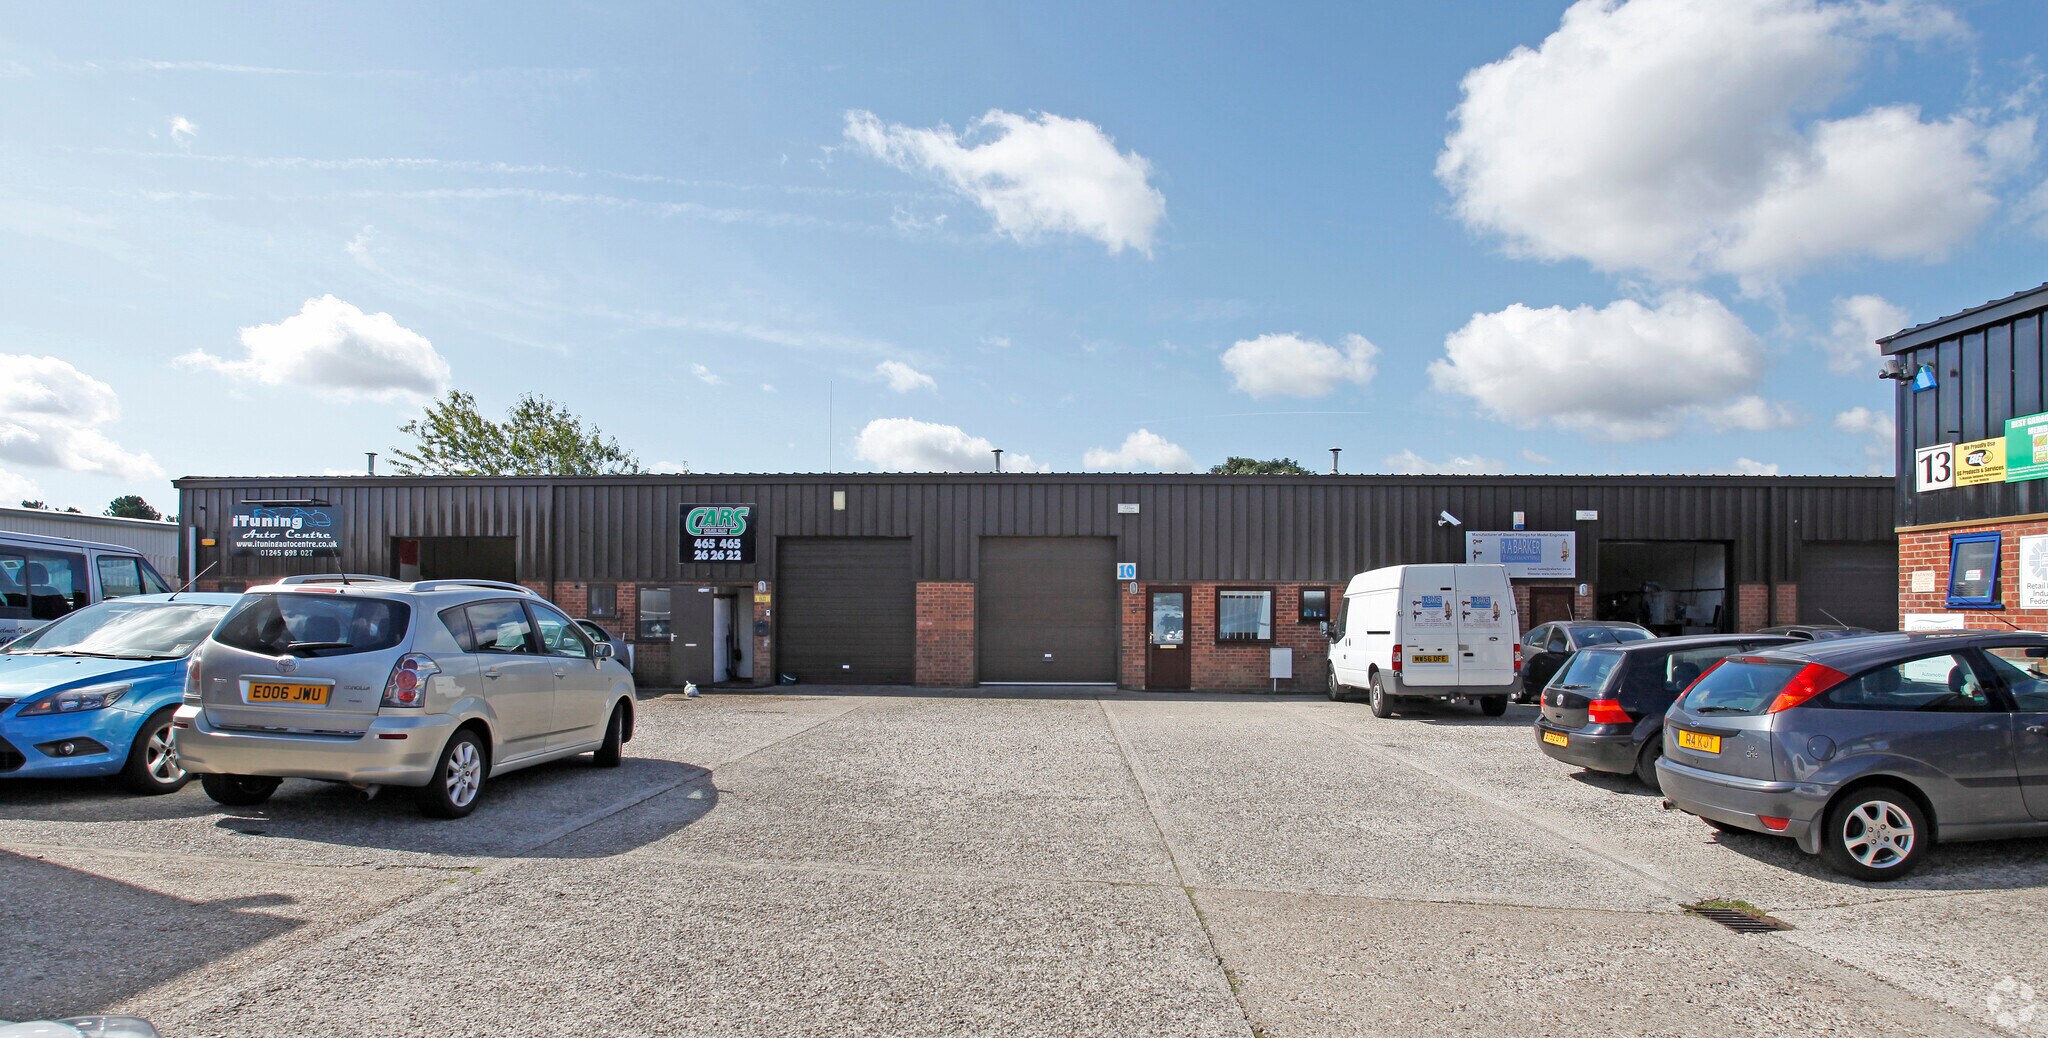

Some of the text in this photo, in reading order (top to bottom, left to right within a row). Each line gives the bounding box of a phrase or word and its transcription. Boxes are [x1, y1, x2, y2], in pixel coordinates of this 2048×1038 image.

[2011, 418, 2026, 428] BEST
[1920, 451, 1950, 484] 13
[232, 515, 302, 529] iTuning
[686, 508, 749, 536] CARS
[242, 529, 331, 538] Auto Centre
[694, 539, 740, 548] 465 465
[694, 550, 741, 560] 26 26 22
[1119, 564, 1134, 578] 10
[293, 688, 321, 700] JWU
[1686, 733, 1696, 745] R4
